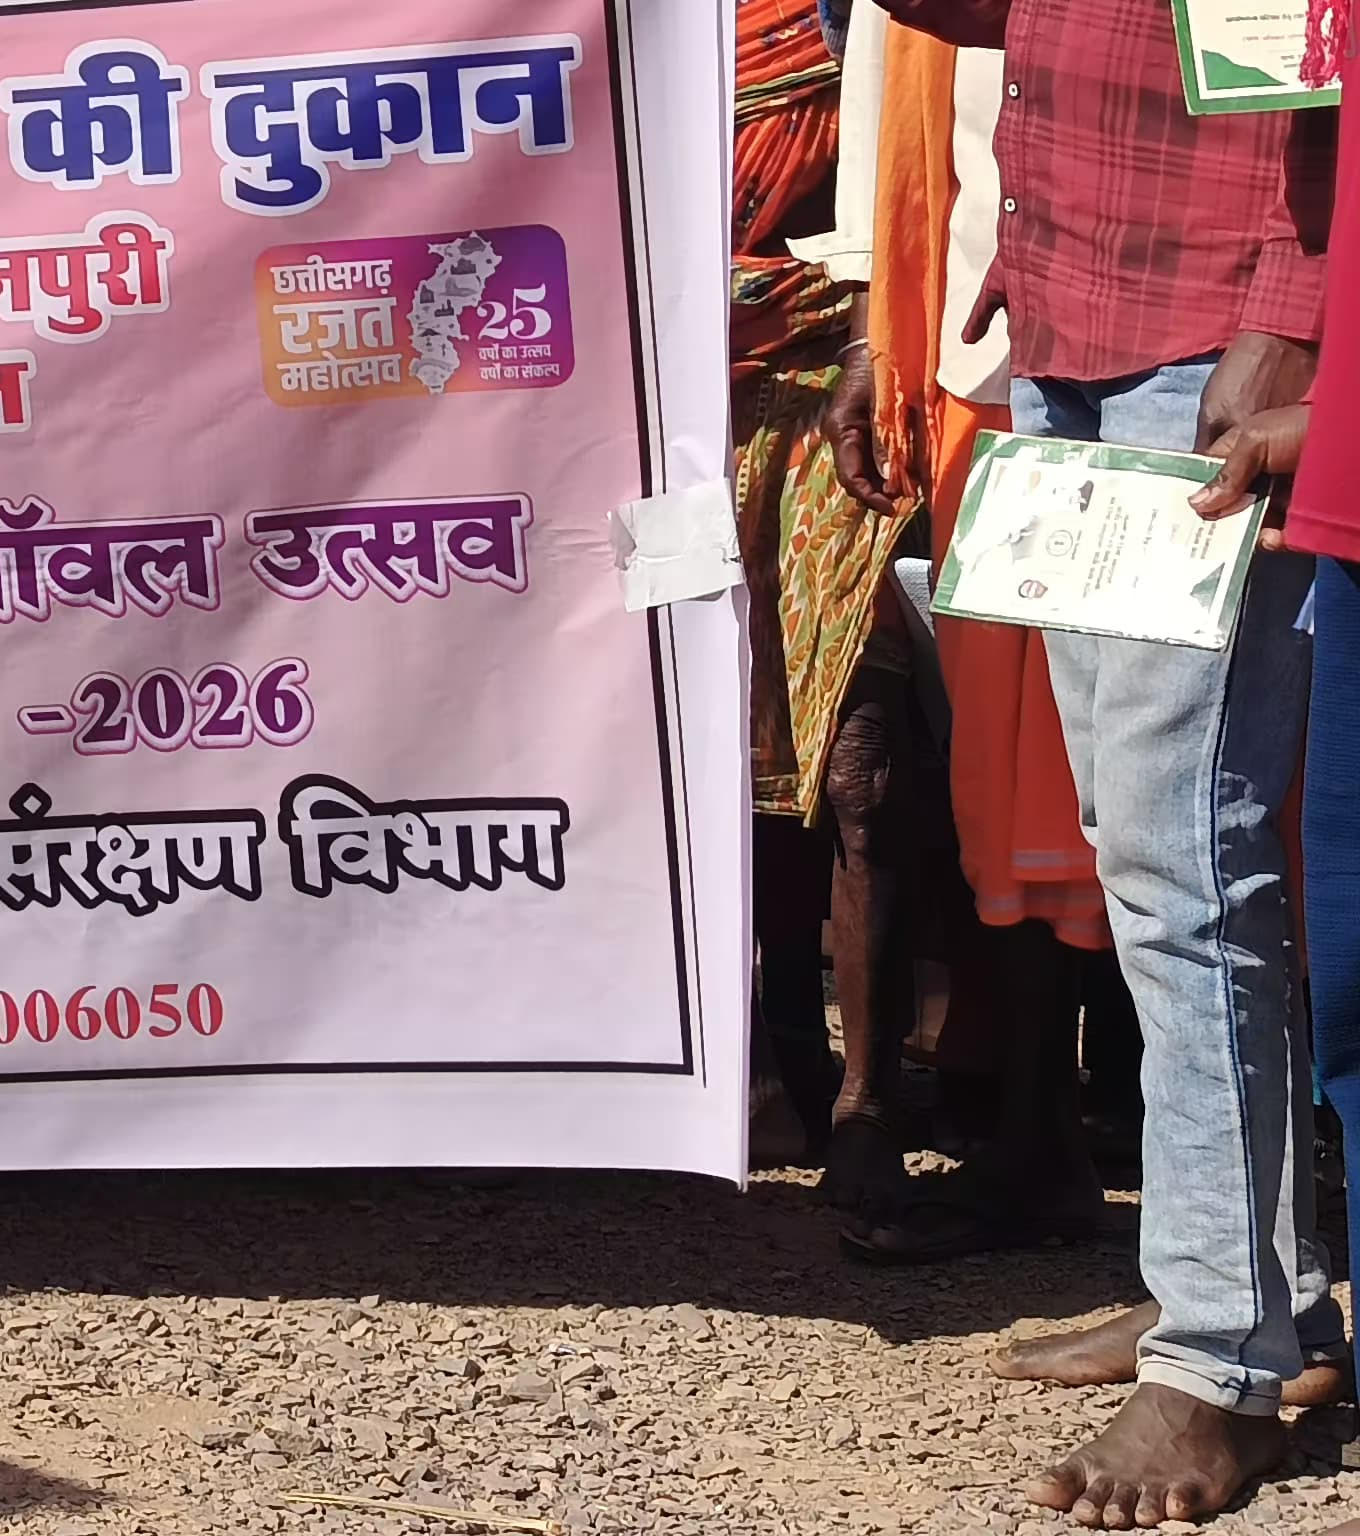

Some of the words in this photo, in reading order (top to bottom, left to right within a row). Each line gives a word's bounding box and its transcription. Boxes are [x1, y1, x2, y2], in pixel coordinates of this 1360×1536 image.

[12, 50, 182, 182] की
[213, 46, 574, 206] दुकान
[273, 297, 397, 354] रजत
[477, 283, 553, 340] 25
[276, 350, 402, 392] महोत्सव
[501, 346, 517, 359] का
[519, 344, 551, 359] उत्सव
[503, 365, 519, 379] का
[521, 362, 560, 379] संकल्प
[254, 498, 522, 591] उत्सव
[280, 773, 570, 897] विभाग
